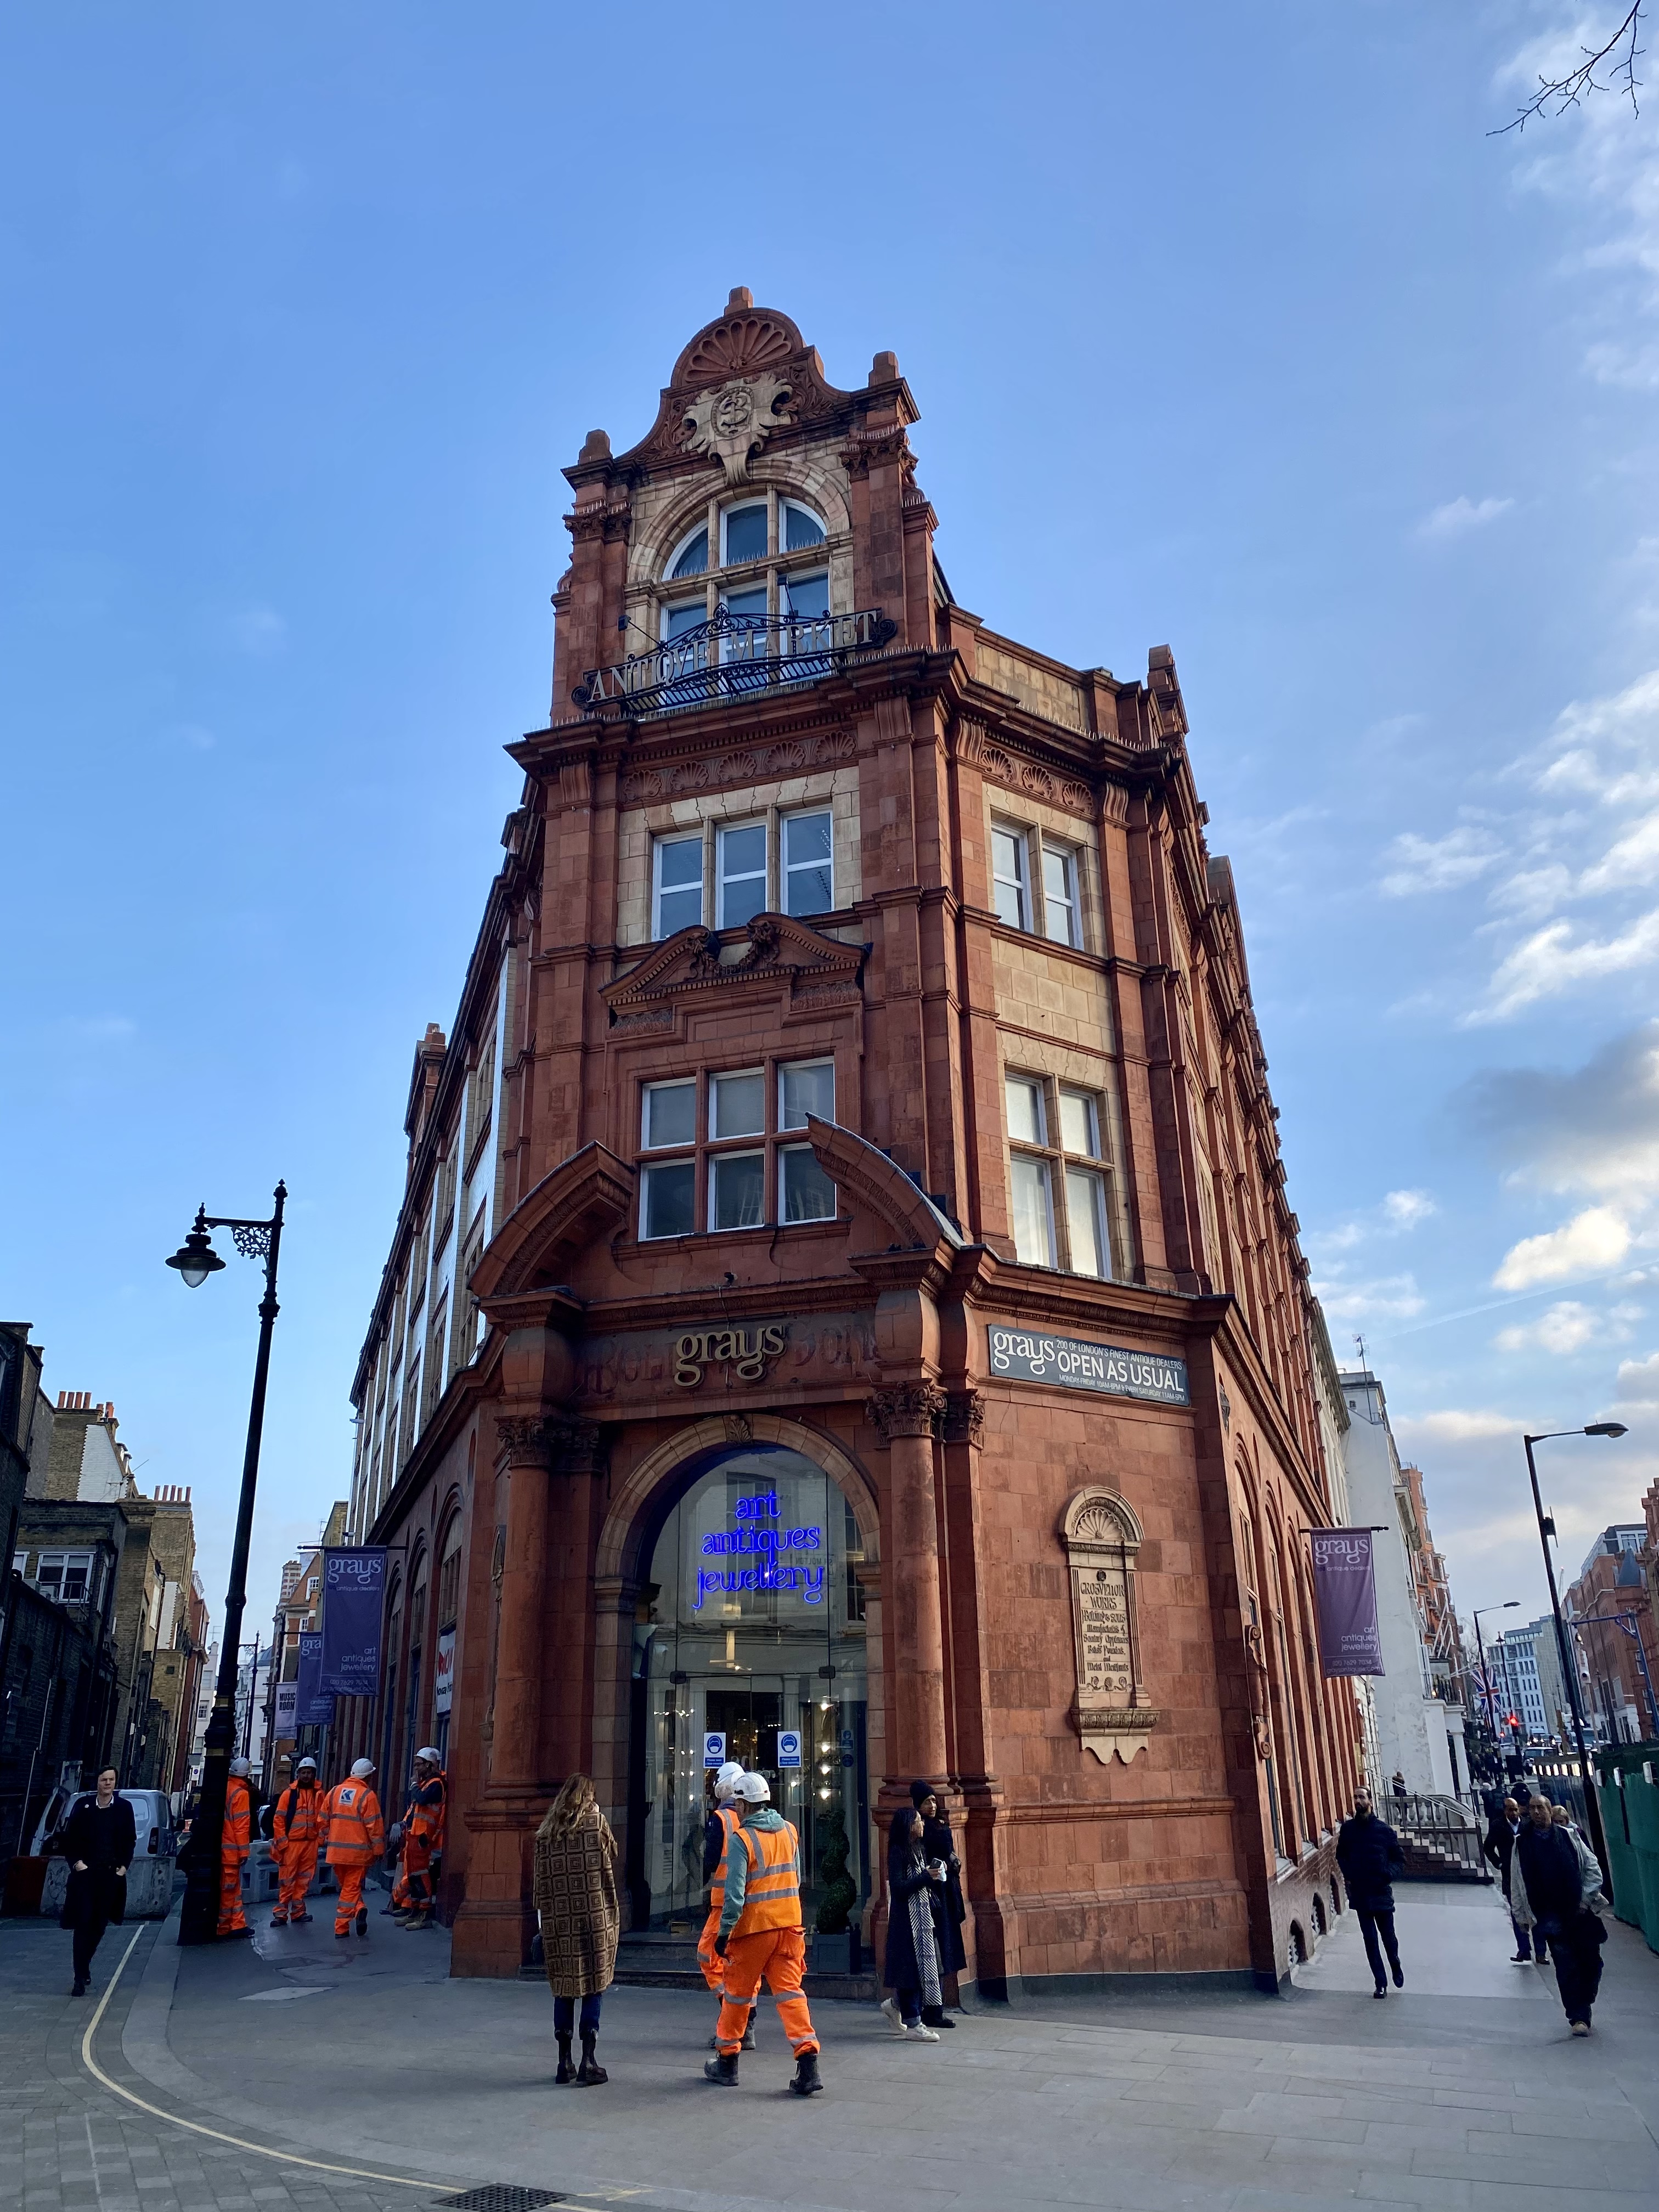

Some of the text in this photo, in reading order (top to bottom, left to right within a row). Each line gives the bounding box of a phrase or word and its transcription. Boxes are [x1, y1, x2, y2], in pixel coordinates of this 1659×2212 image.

[587, 610, 878, 703] ANTIQVE MARKET
[674, 1325, 787, 1387] grays
[994, 1332, 1056, 1375] grays
[1056, 1340, 1182, 1370] 200 OF LONDON'S FINEST ANTIQUE DEALERS
[1057, 1351, 1184, 1392] OPEN AS USUAL
[1059, 1374, 1096, 1386] MONDAY-FRIDAY
[1125, 1385, 1138, 1393] EVERY
[1139, 1387, 1161, 1397] SATURDAY
[735, 1489, 781, 1520] art
[701, 1525, 820, 1567] antiques
[1315, 1539, 1369, 1565] grays
[328, 1559, 382, 1584] grays
[692, 1562, 824, 1609] jewellery
[1090, 1596, 1117, 1609] WORKS
[301, 1640, 321, 1656] gra
[1341, 1634, 1376, 1643] antiques
[341, 1654, 376, 1663] antiques
[279, 1692, 296, 1701] MUSIC
[279, 1701, 295, 1711] ROOM
